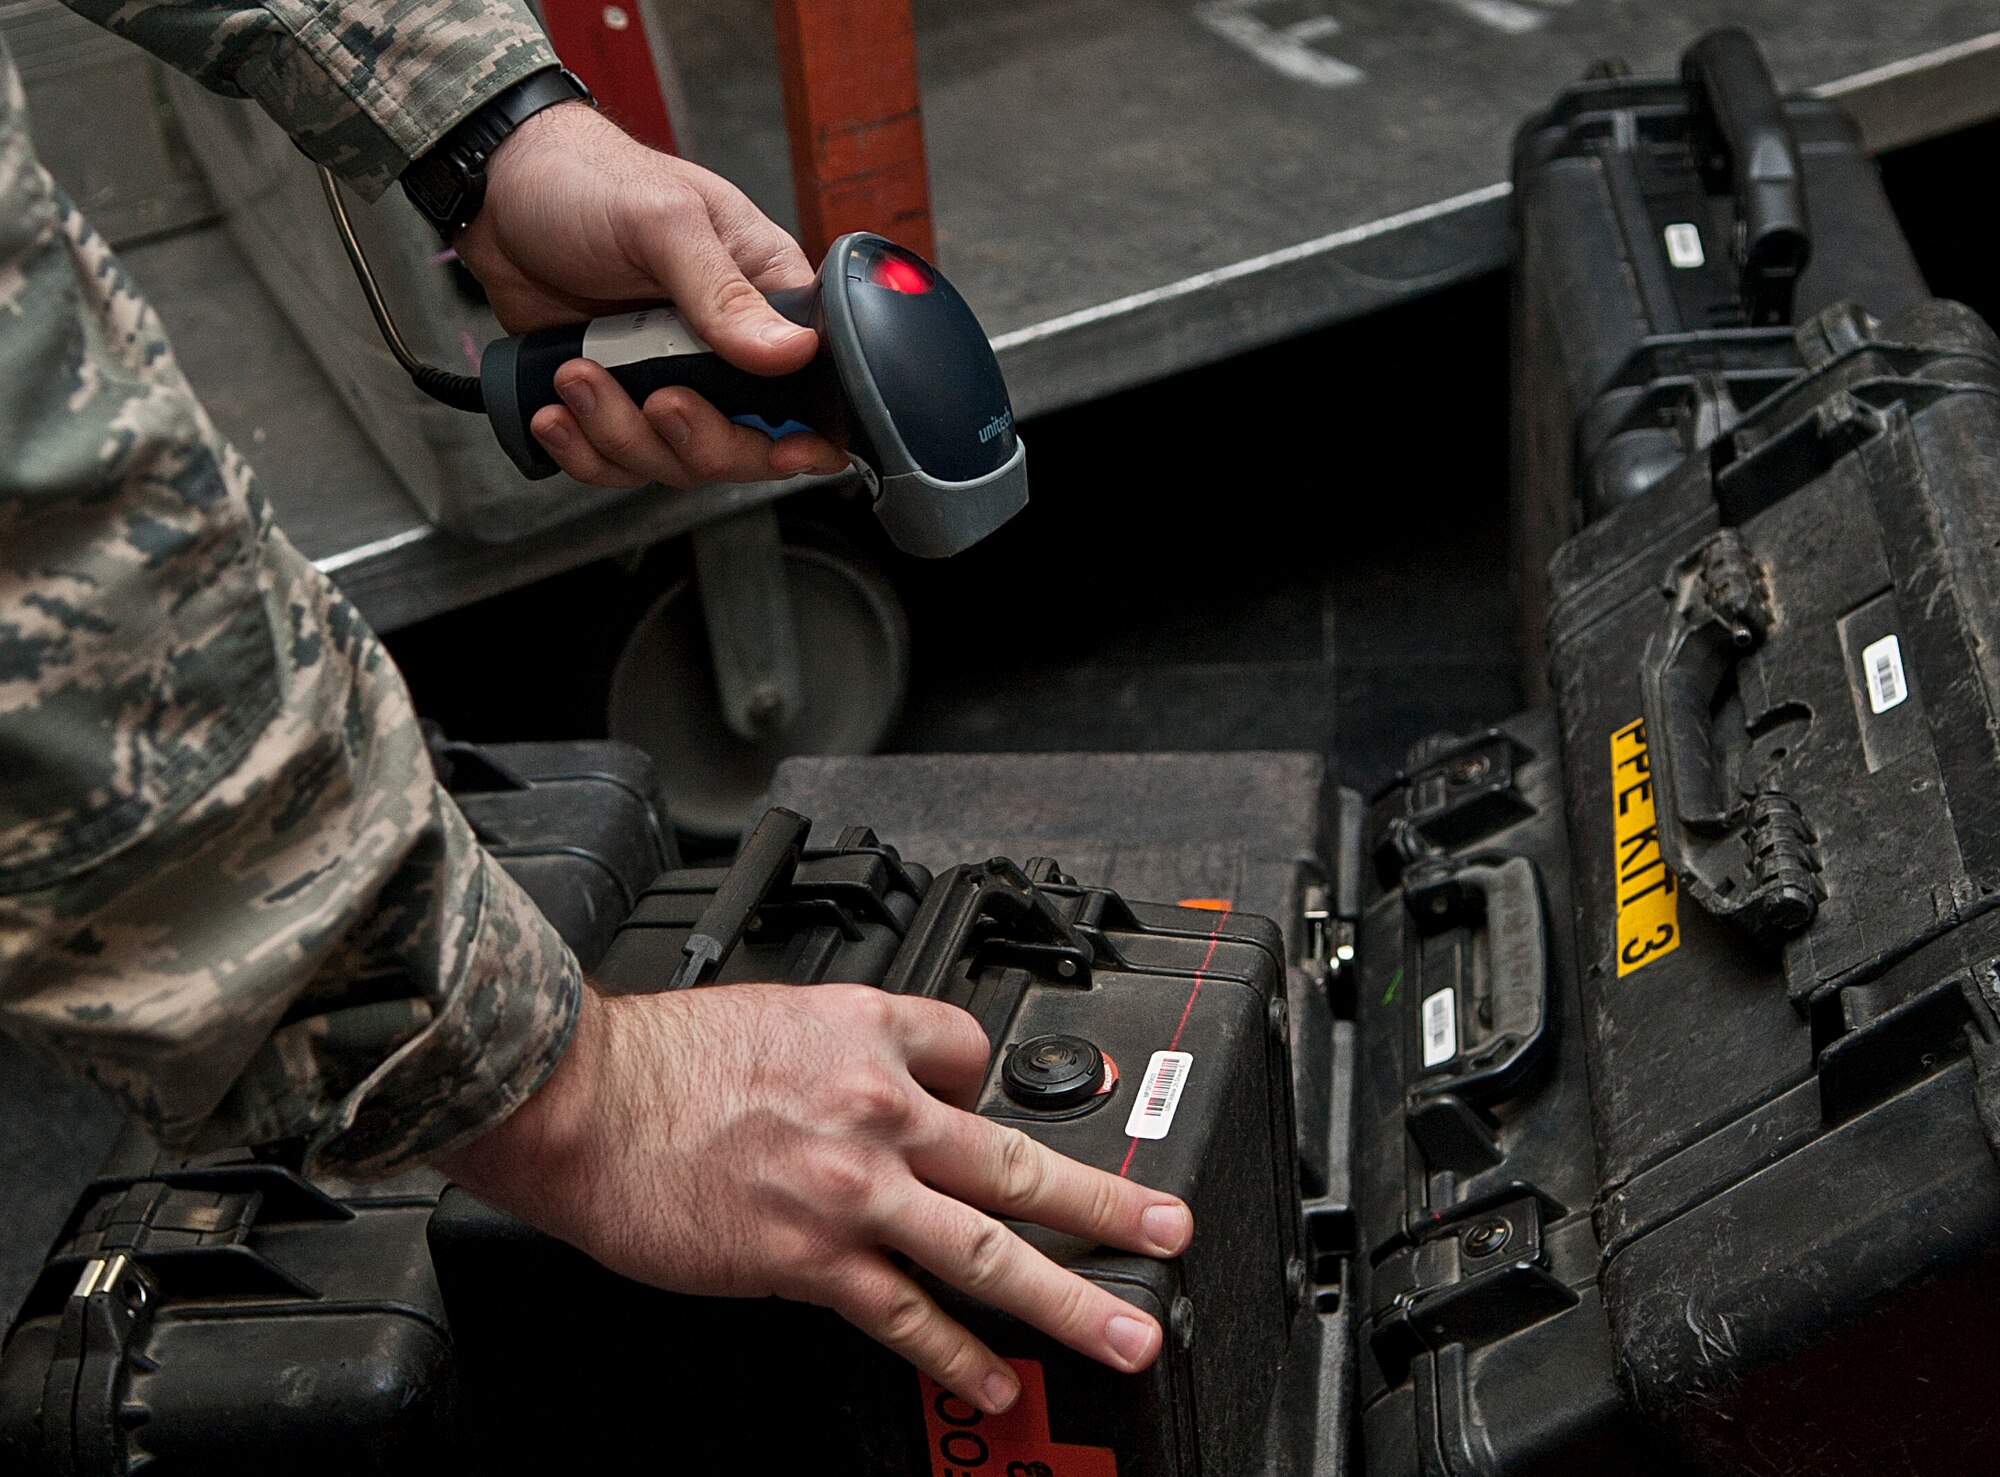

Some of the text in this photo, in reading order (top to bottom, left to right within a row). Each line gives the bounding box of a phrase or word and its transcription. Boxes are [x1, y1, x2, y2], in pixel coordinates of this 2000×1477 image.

[978, 406, 1012, 443] unitech
[1617, 725, 1676, 965] PPE KIT 3
